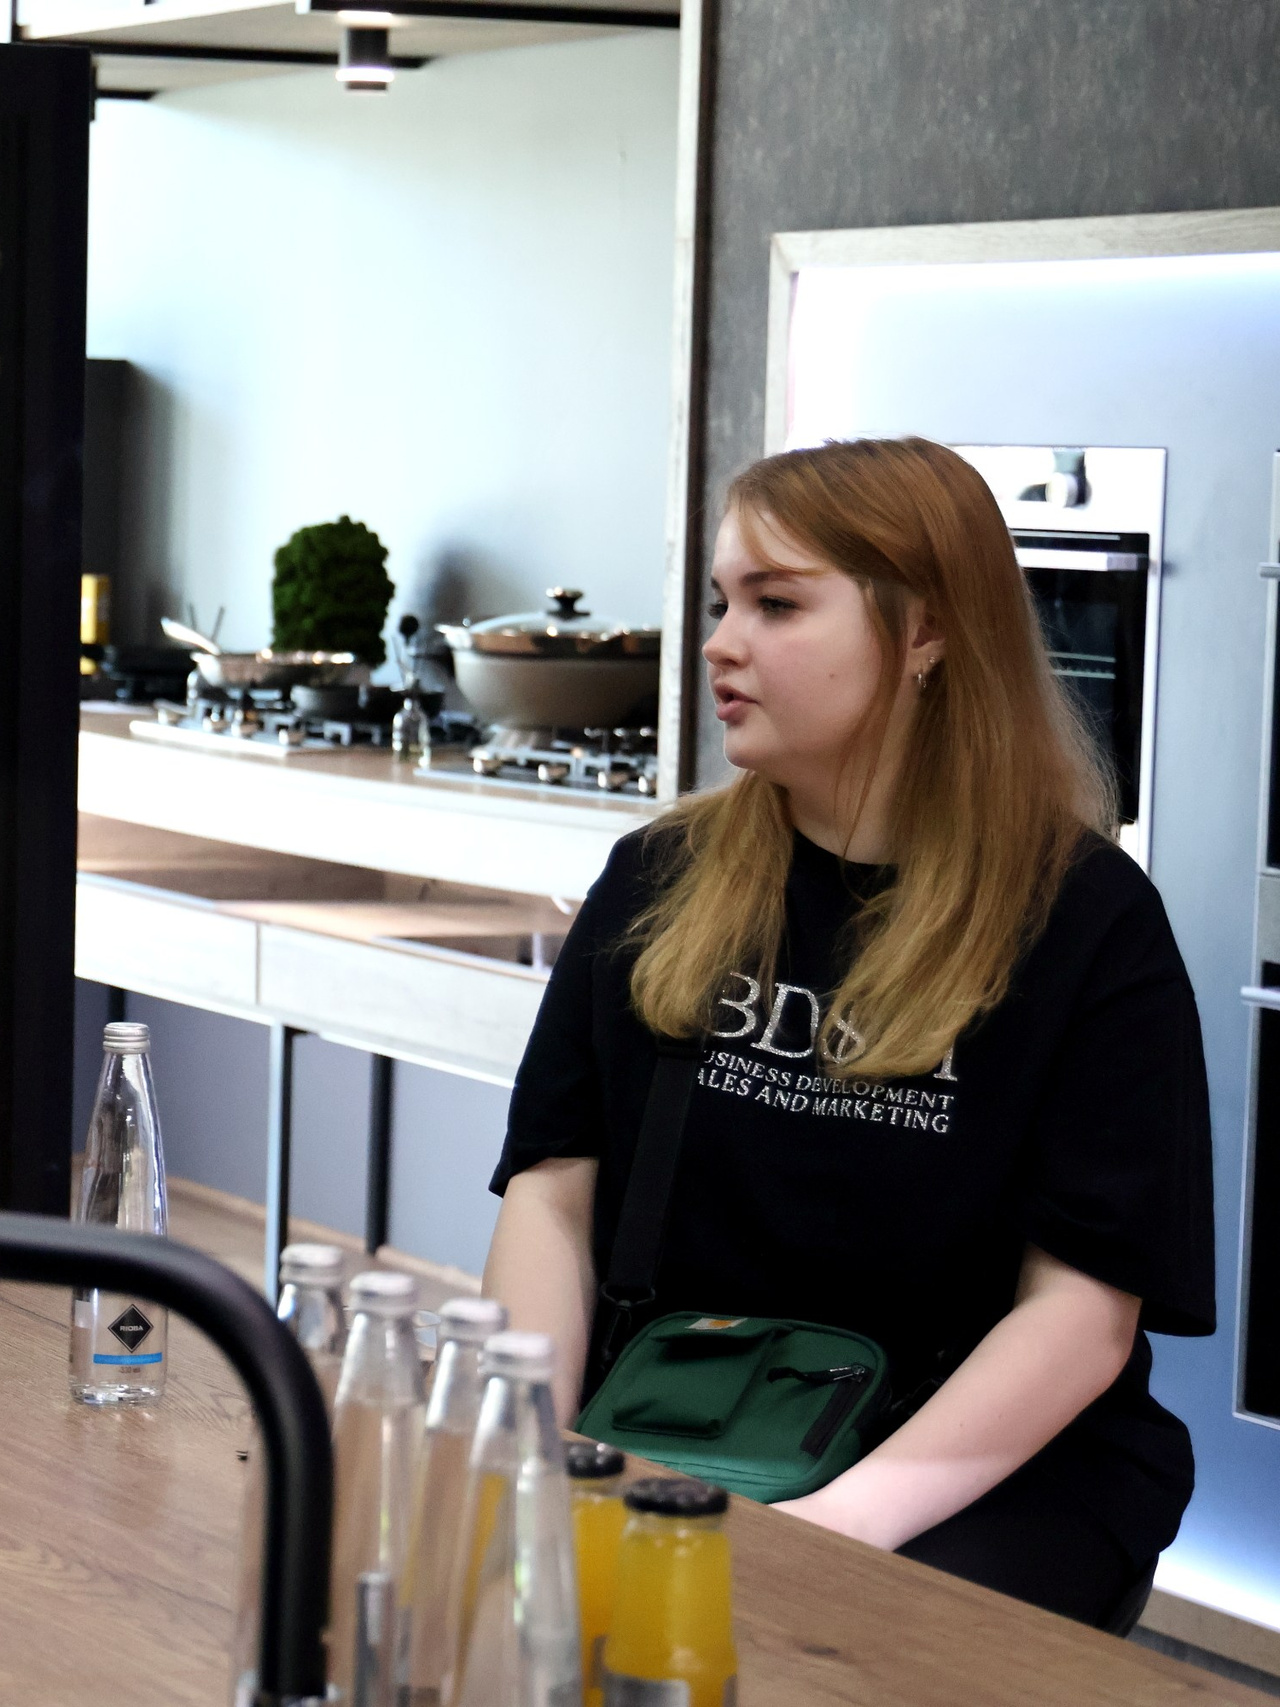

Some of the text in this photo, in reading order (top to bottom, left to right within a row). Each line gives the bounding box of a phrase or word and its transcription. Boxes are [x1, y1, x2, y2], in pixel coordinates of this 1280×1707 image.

[703, 1050, 955, 1111] USINESS DEVELOPMENT
[754, 1085, 809, 1112] AND
[811, 1096, 950, 1134] MARKETING
